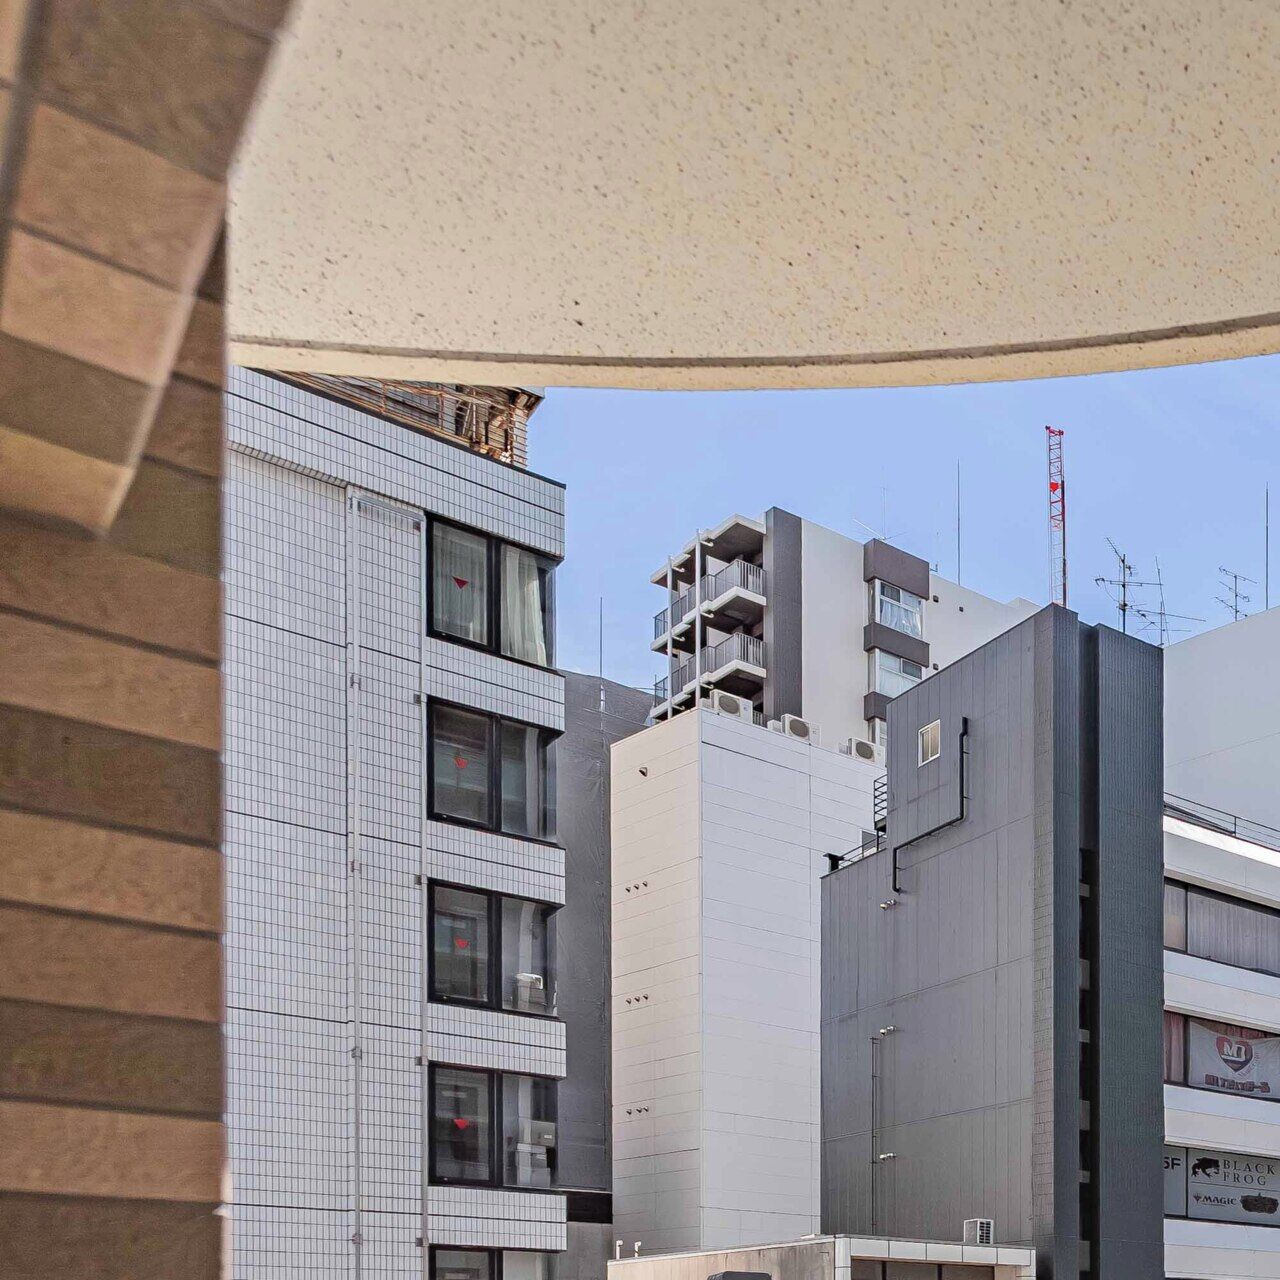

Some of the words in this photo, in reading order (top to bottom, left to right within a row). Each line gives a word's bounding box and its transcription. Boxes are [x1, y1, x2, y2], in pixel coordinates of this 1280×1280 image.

[1222, 1159, 1276, 1175] BLACK
[1223, 1171, 1266, 1186] FROG
[1202, 1195, 1237, 1205] MAGIC
